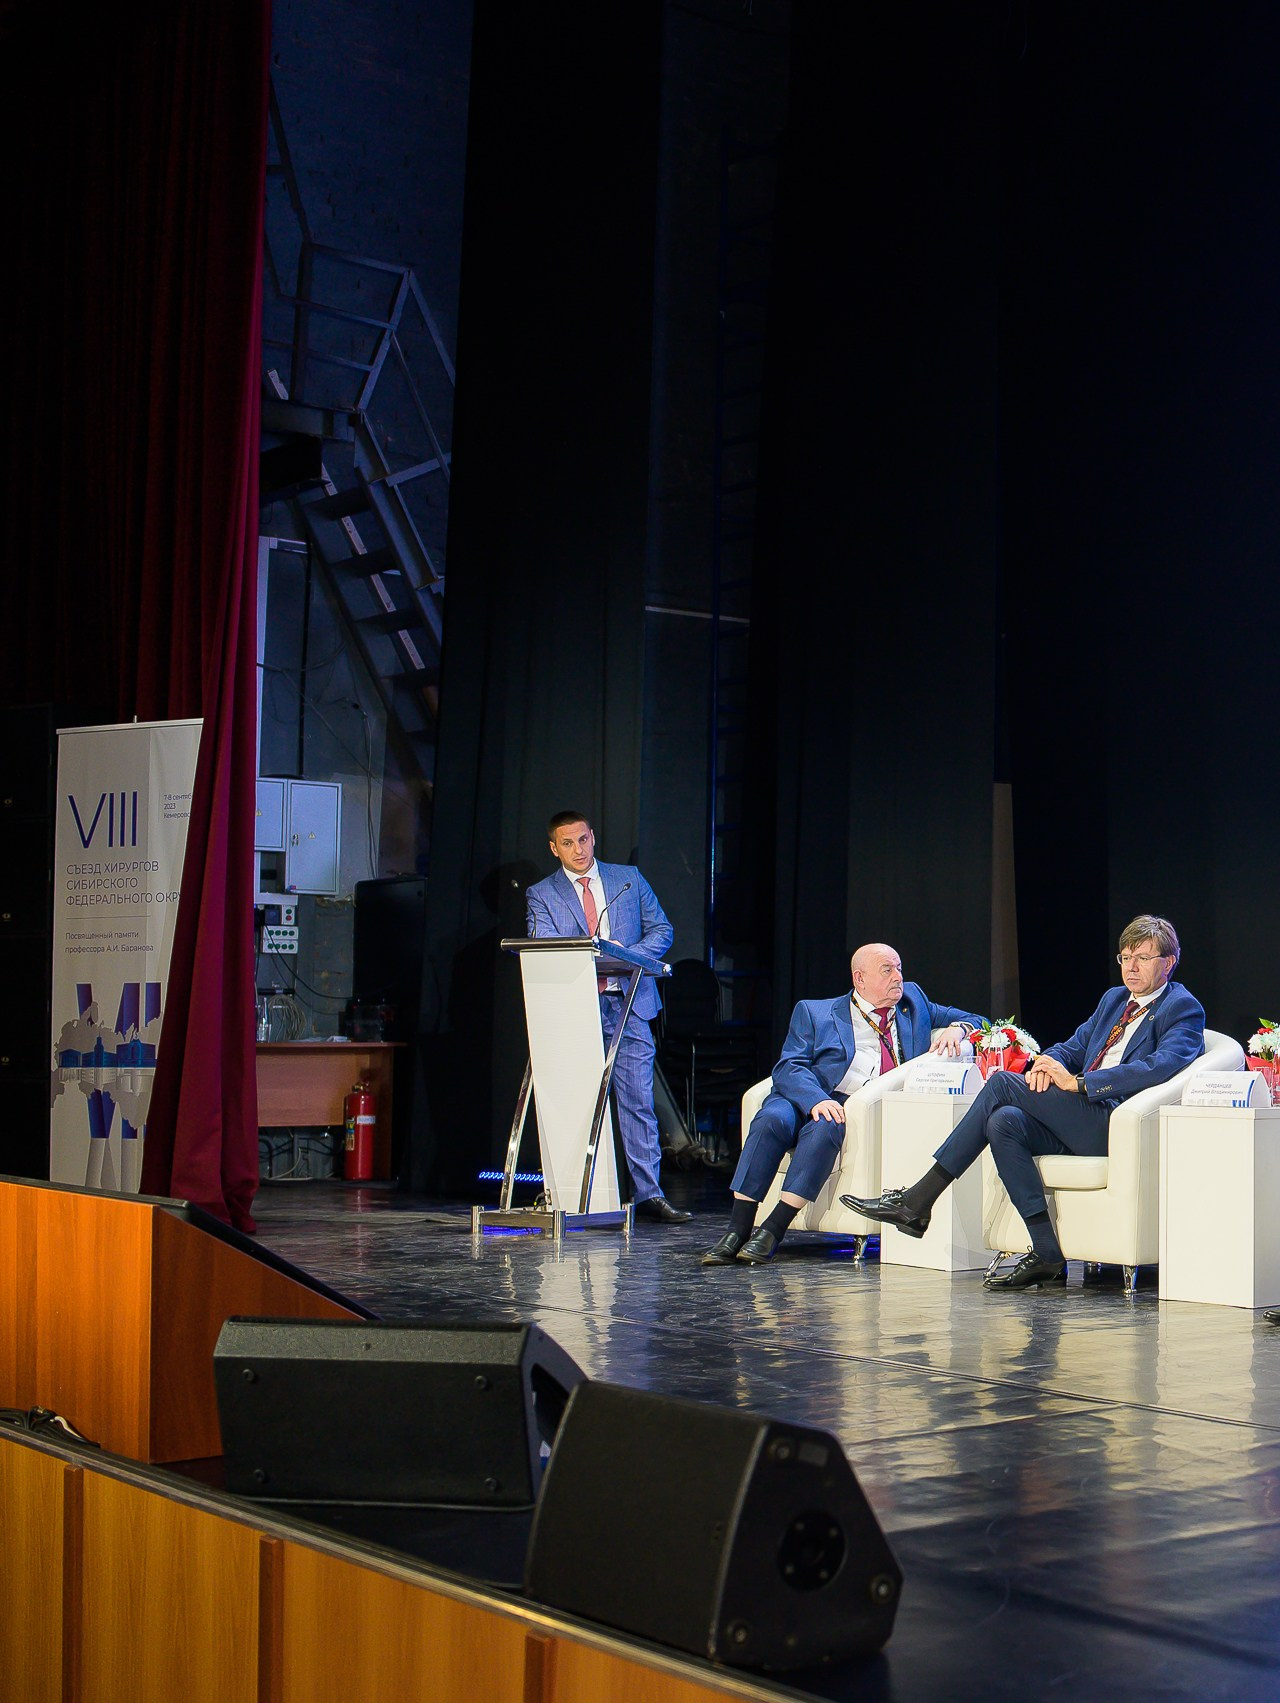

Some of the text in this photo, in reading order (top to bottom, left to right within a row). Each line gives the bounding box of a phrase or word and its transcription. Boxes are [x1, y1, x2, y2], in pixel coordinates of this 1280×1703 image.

[68, 791, 138, 849] VIII
[67, 861, 159, 875] СЪЕЗД ХИРУРГОВ
[67, 878, 138, 890] СИБИРСКОГО
[66, 893, 152, 906] ФЕДЕРАЛЬНОГО
[65, 946, 104, 954] профессора
[121, 944, 153, 952] Баранова
